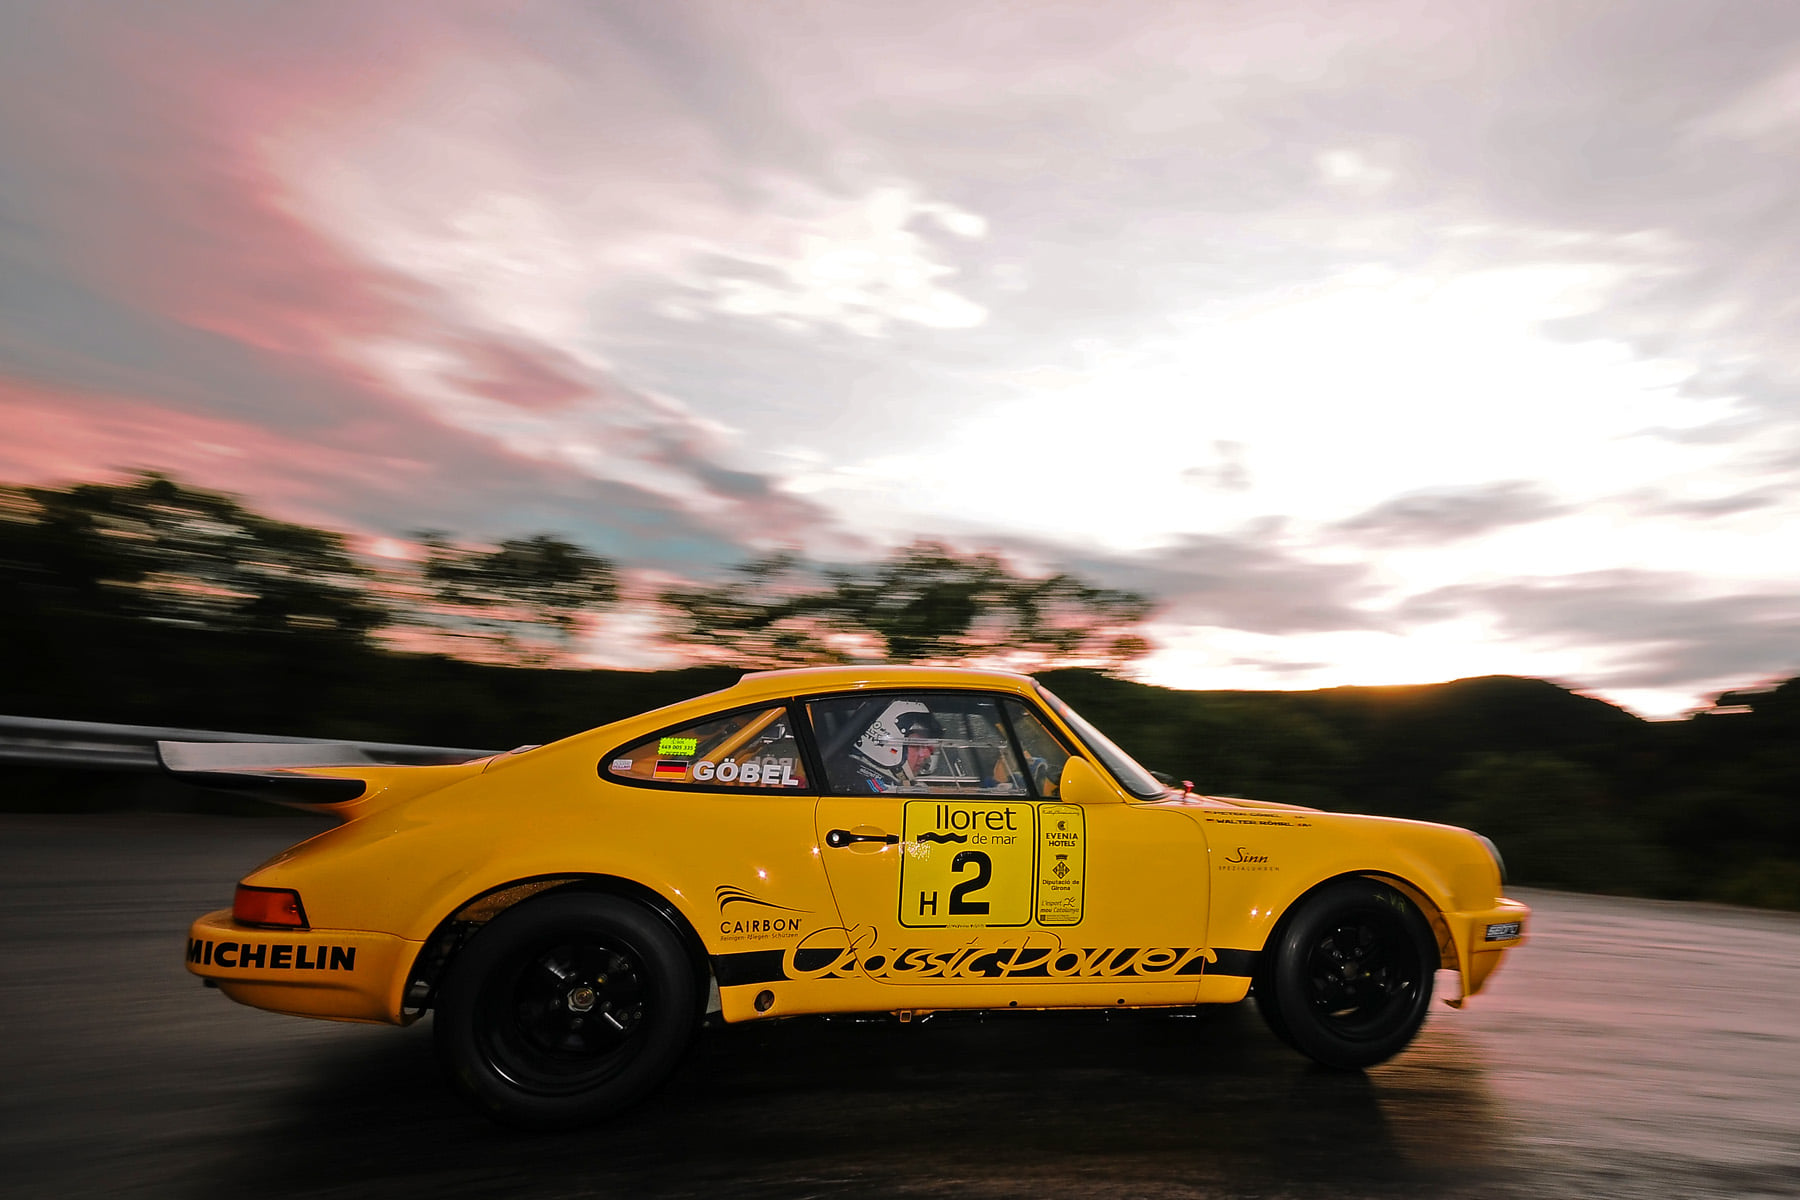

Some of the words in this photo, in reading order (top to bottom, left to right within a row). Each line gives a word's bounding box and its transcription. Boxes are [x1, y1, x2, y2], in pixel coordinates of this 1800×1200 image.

[693, 758, 799, 785] GÖBEL
[936, 804, 1017, 831] lloret
[971, 833, 987, 845] de
[991, 836, 1017, 845] mar
[1045, 832, 1079, 840] EVENIA
[1225, 846, 1269, 864] Sinn
[948, 850, 992, 916] 2
[919, 891, 938, 916] H
[187, 937, 357, 972] MICHELIN
[997, 930, 1217, 978] Power
